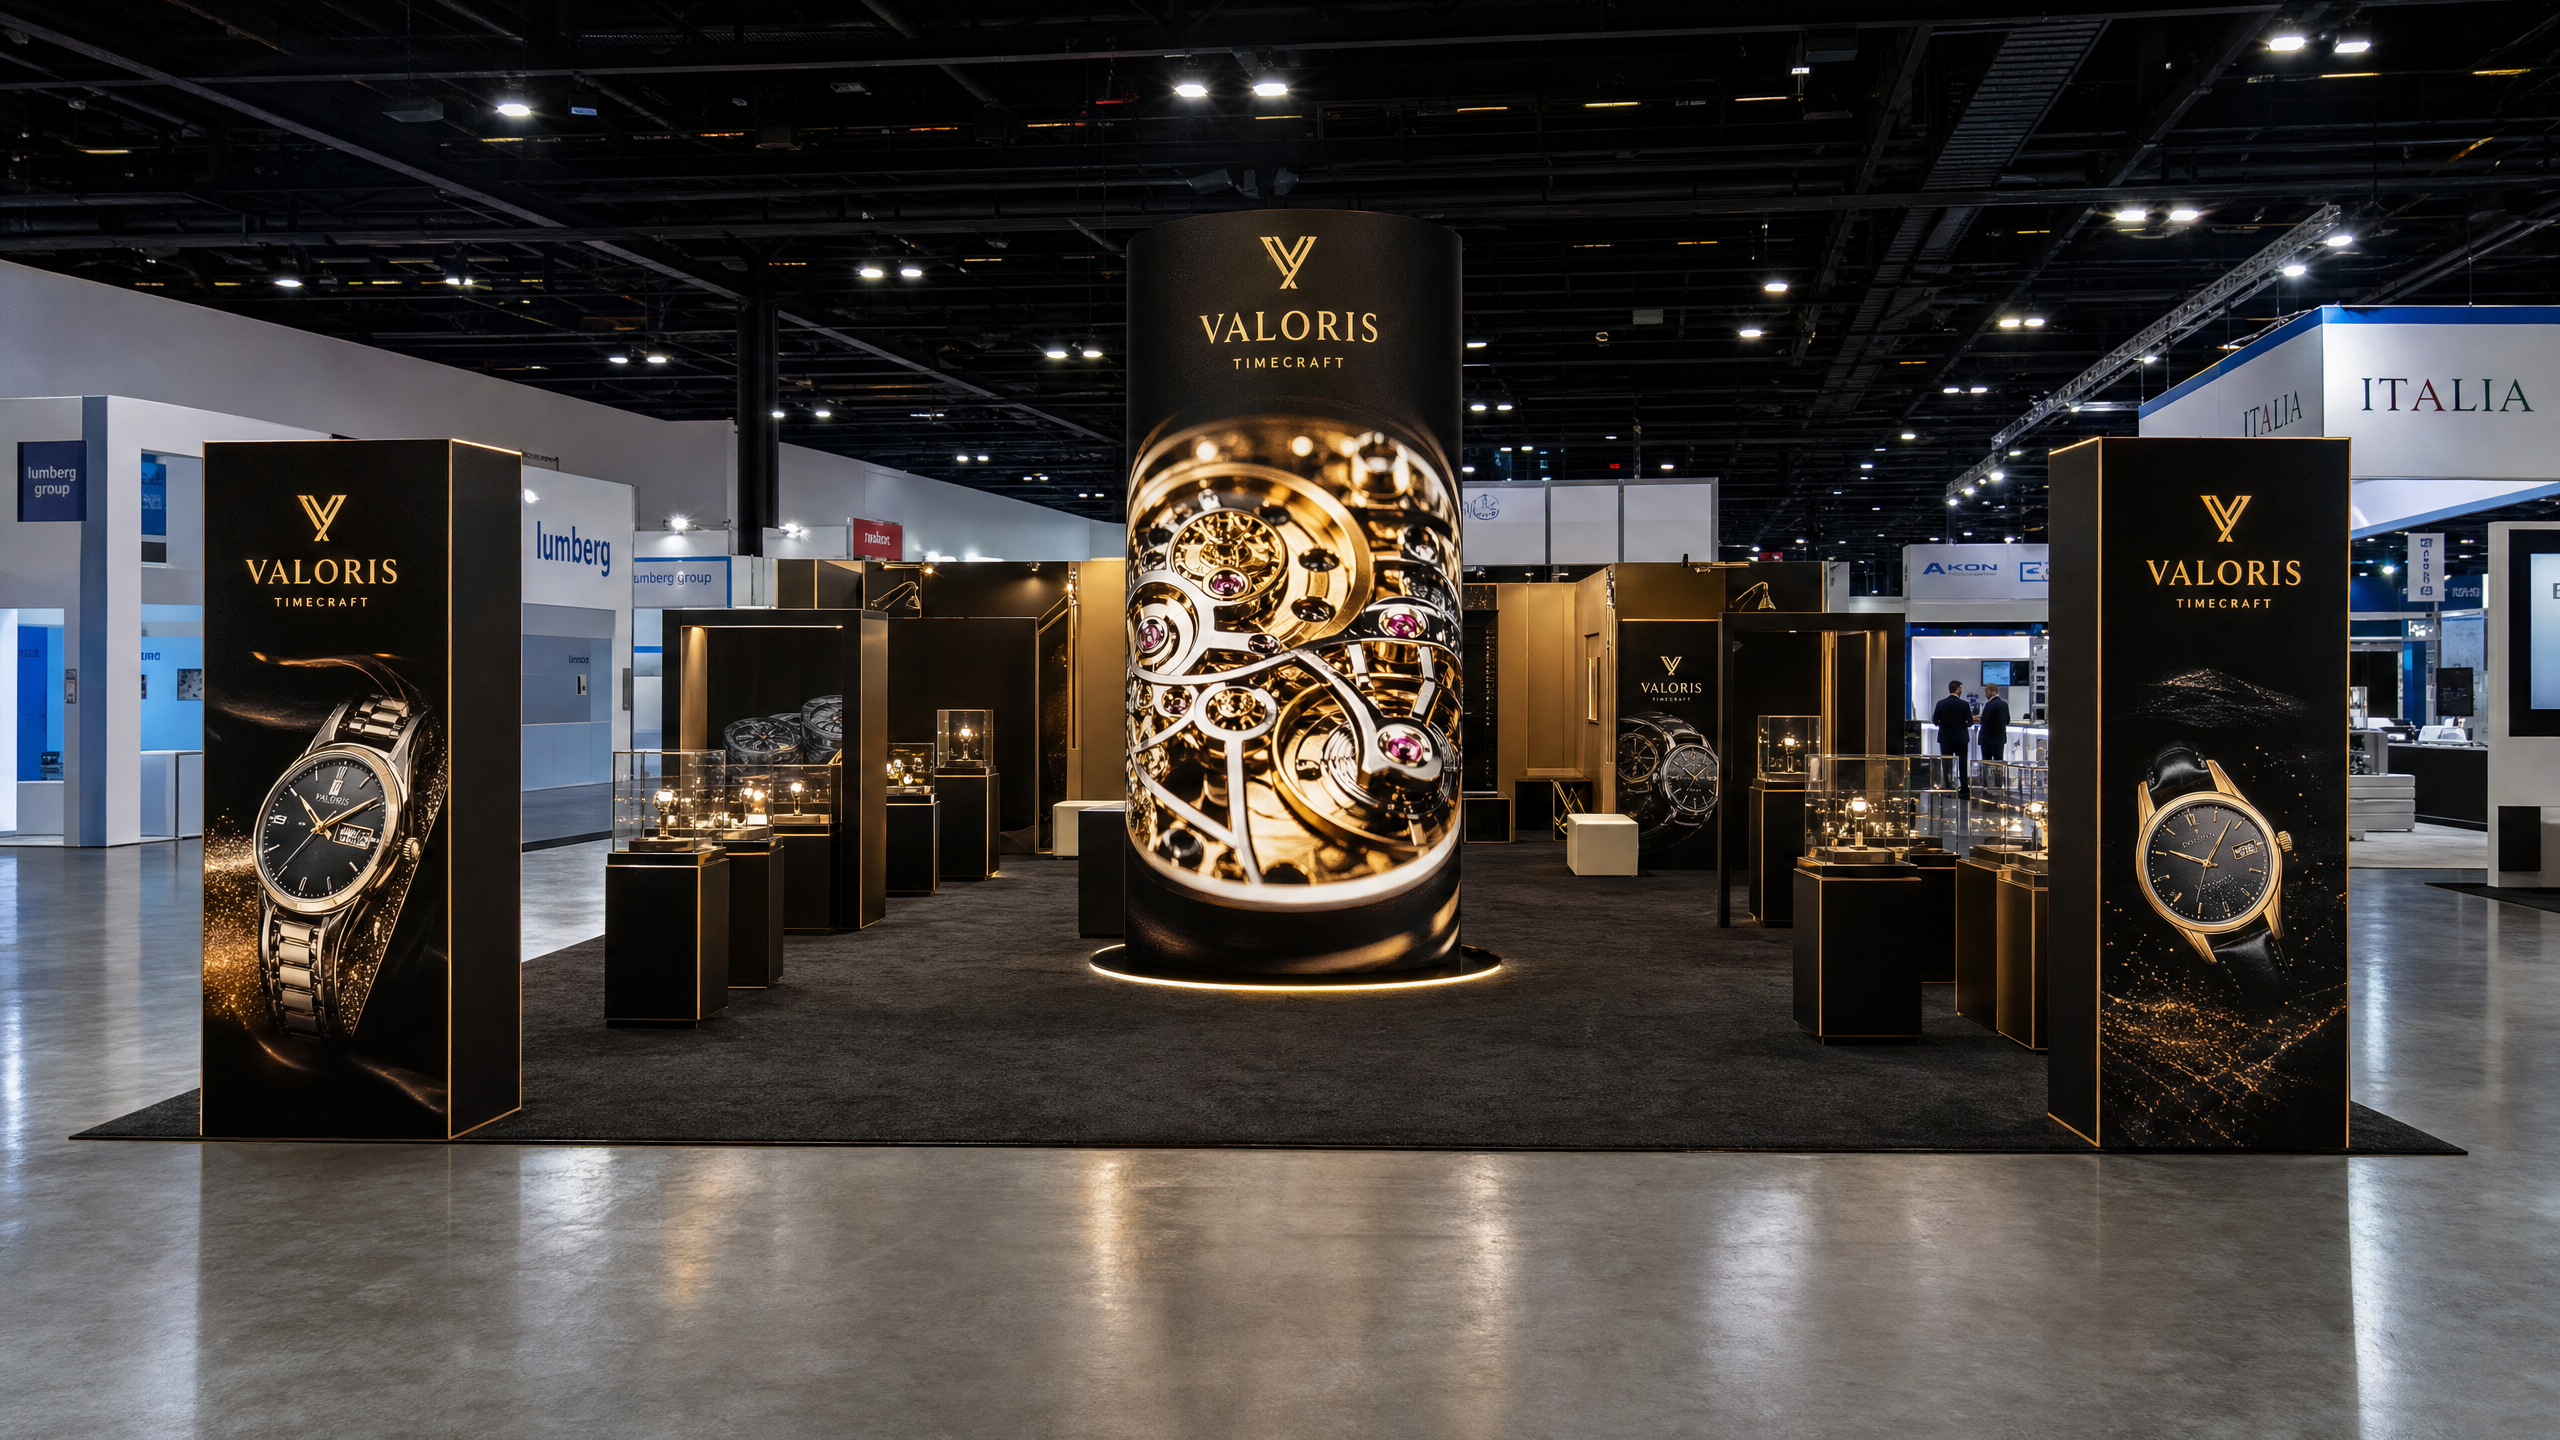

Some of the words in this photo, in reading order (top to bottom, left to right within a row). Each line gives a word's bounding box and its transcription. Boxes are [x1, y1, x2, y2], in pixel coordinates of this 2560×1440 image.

[1199, 310, 1378, 344] VALORIS
[1233, 357, 1343, 370] TIMECRAFT
[2361, 377, 2534, 412] ITALIA
[2243, 390, 2303, 437] ITALIA
[28, 466, 76, 482] lumberg
[34, 484, 70, 498] group
[536, 521, 611, 577] lumberg
[245, 559, 398, 584] VALORIS
[1922, 563, 1998, 575] AKON
[2146, 560, 2302, 586] VALORIS
[633, 571, 675, 586] umberg
[677, 573, 712, 586] group
[274, 597, 368, 607] TIMECRAFT
[2176, 599, 2272, 609] TIMECRAFT
[1641, 682, 1702, 694] VALORIS
